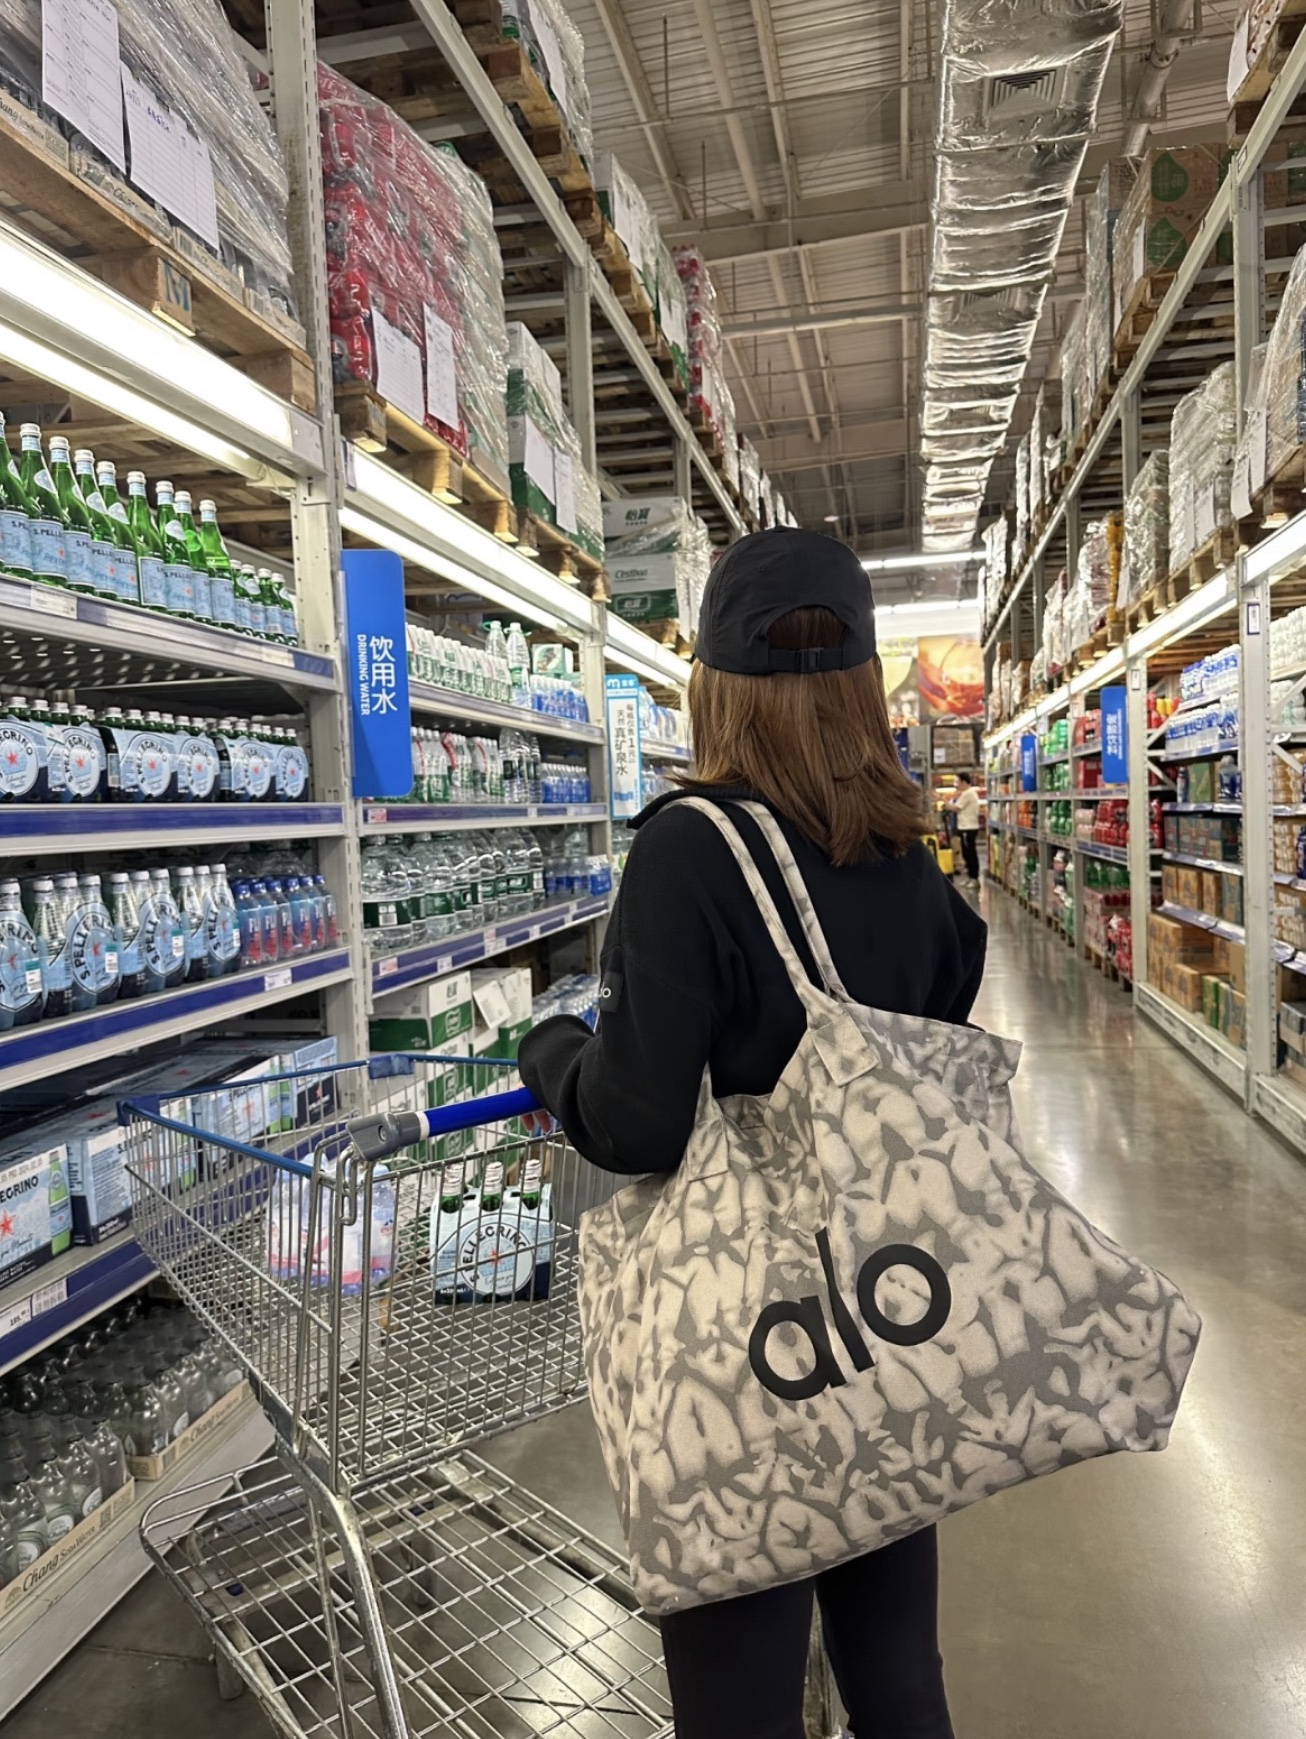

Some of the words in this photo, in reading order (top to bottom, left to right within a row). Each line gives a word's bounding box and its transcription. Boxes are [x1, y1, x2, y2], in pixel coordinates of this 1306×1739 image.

[357, 634, 369, 681] DRINKING
[369, 635, 398, 715] 饮用水
[359, 682, 371, 716] WATER
[748, 1227, 952, 1401] alo
[23, 1554, 59, 1592] Chang
